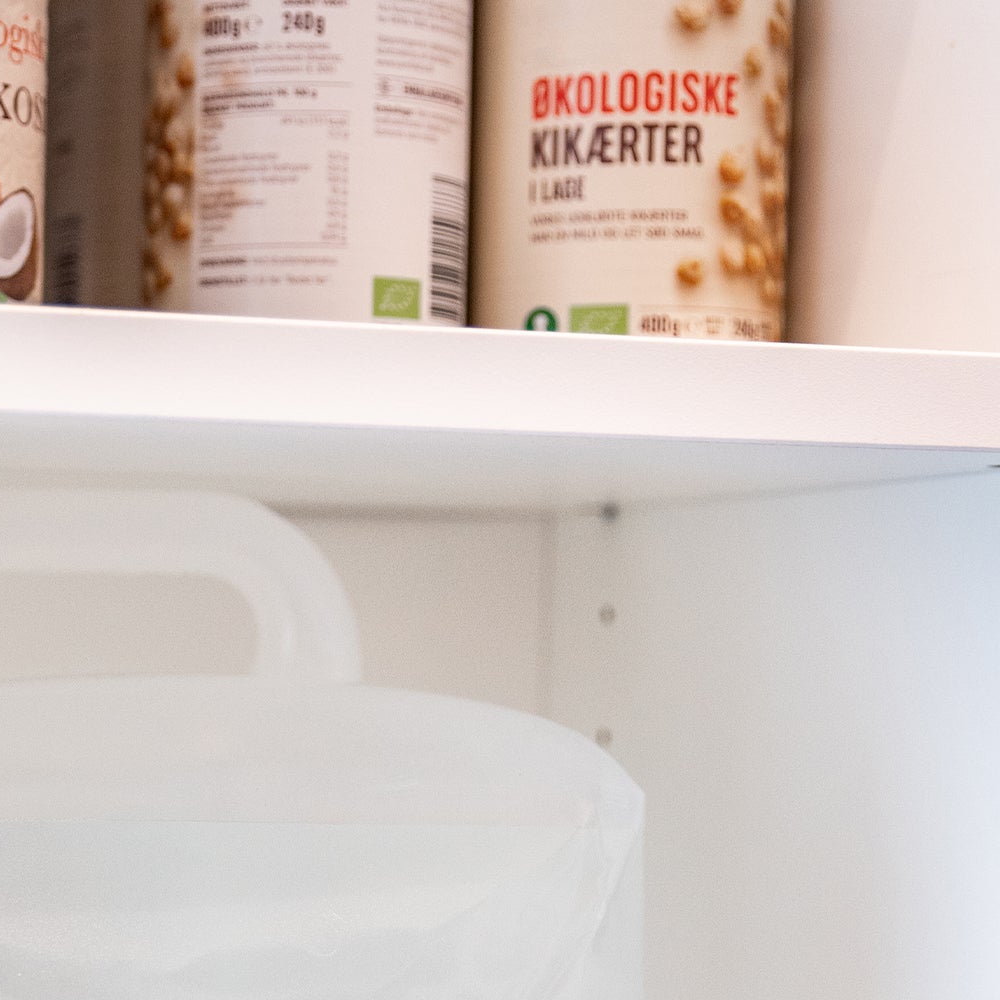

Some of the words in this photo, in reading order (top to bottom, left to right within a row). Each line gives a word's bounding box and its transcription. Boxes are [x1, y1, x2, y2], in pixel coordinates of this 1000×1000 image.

[282, 10, 325, 36] 240g
[532, 71, 739, 120] ØKOLOGISKE
[531, 122, 703, 168] KIKÆRTER
